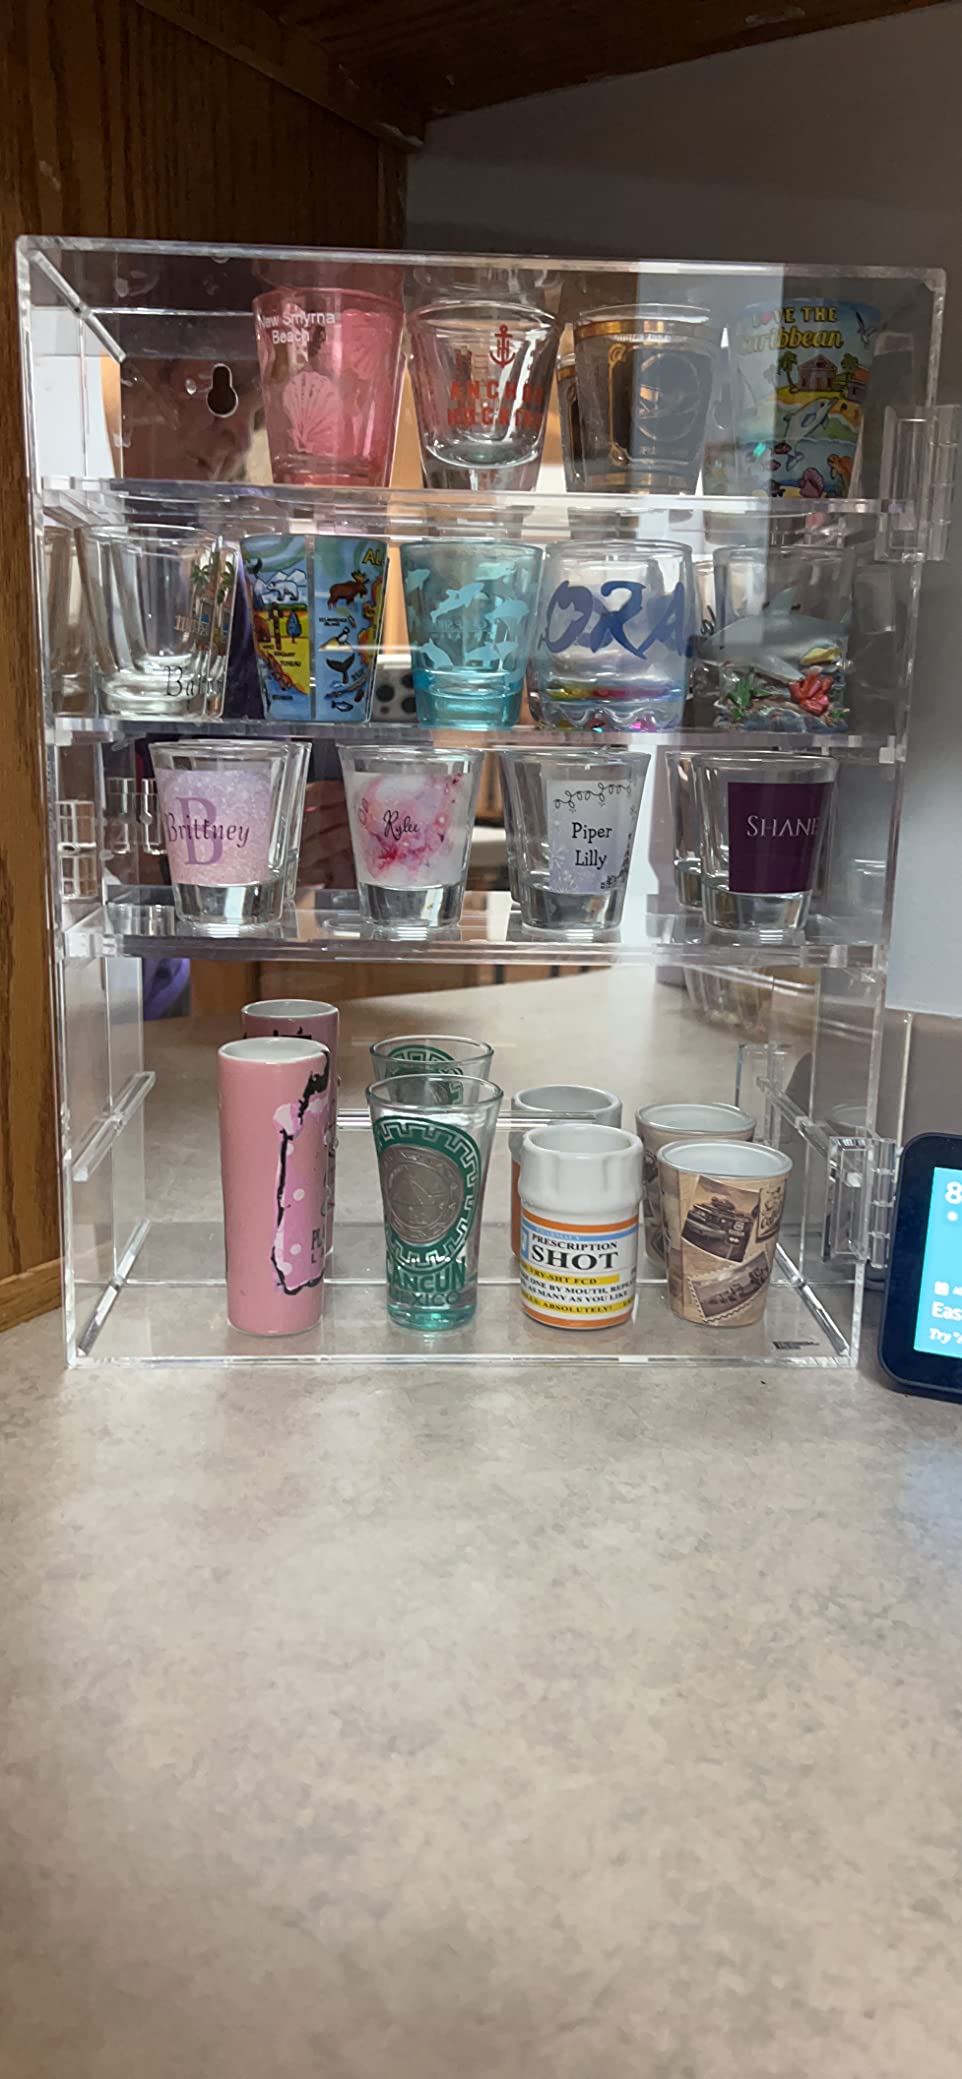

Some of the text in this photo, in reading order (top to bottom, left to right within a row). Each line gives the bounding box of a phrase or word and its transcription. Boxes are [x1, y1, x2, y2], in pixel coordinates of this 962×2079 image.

[257, 311, 336, 330] New Smyrna
[801, 306, 838, 323] THE
[271, 328, 310, 345] Beach
[740, 325, 845, 352] aribbean
[361, 548, 384, 567] AL
[164, 812, 250, 848] Brittney
[383, 809, 420, 841] Rylee
[571, 821, 613, 844] Piper
[575, 850, 608, 871] Lilly
[531, 1232, 619, 1252] PRESCRIPTION
[531, 1244, 619, 1271] SHOT
[530, 1277, 548, 1288] ONE
[549, 1284, 562, 1292] BY
[537, 1287, 567, 1301] MANY
[586, 1295, 607, 1303] YOU
[609, 1291, 628, 1301] LIKE
